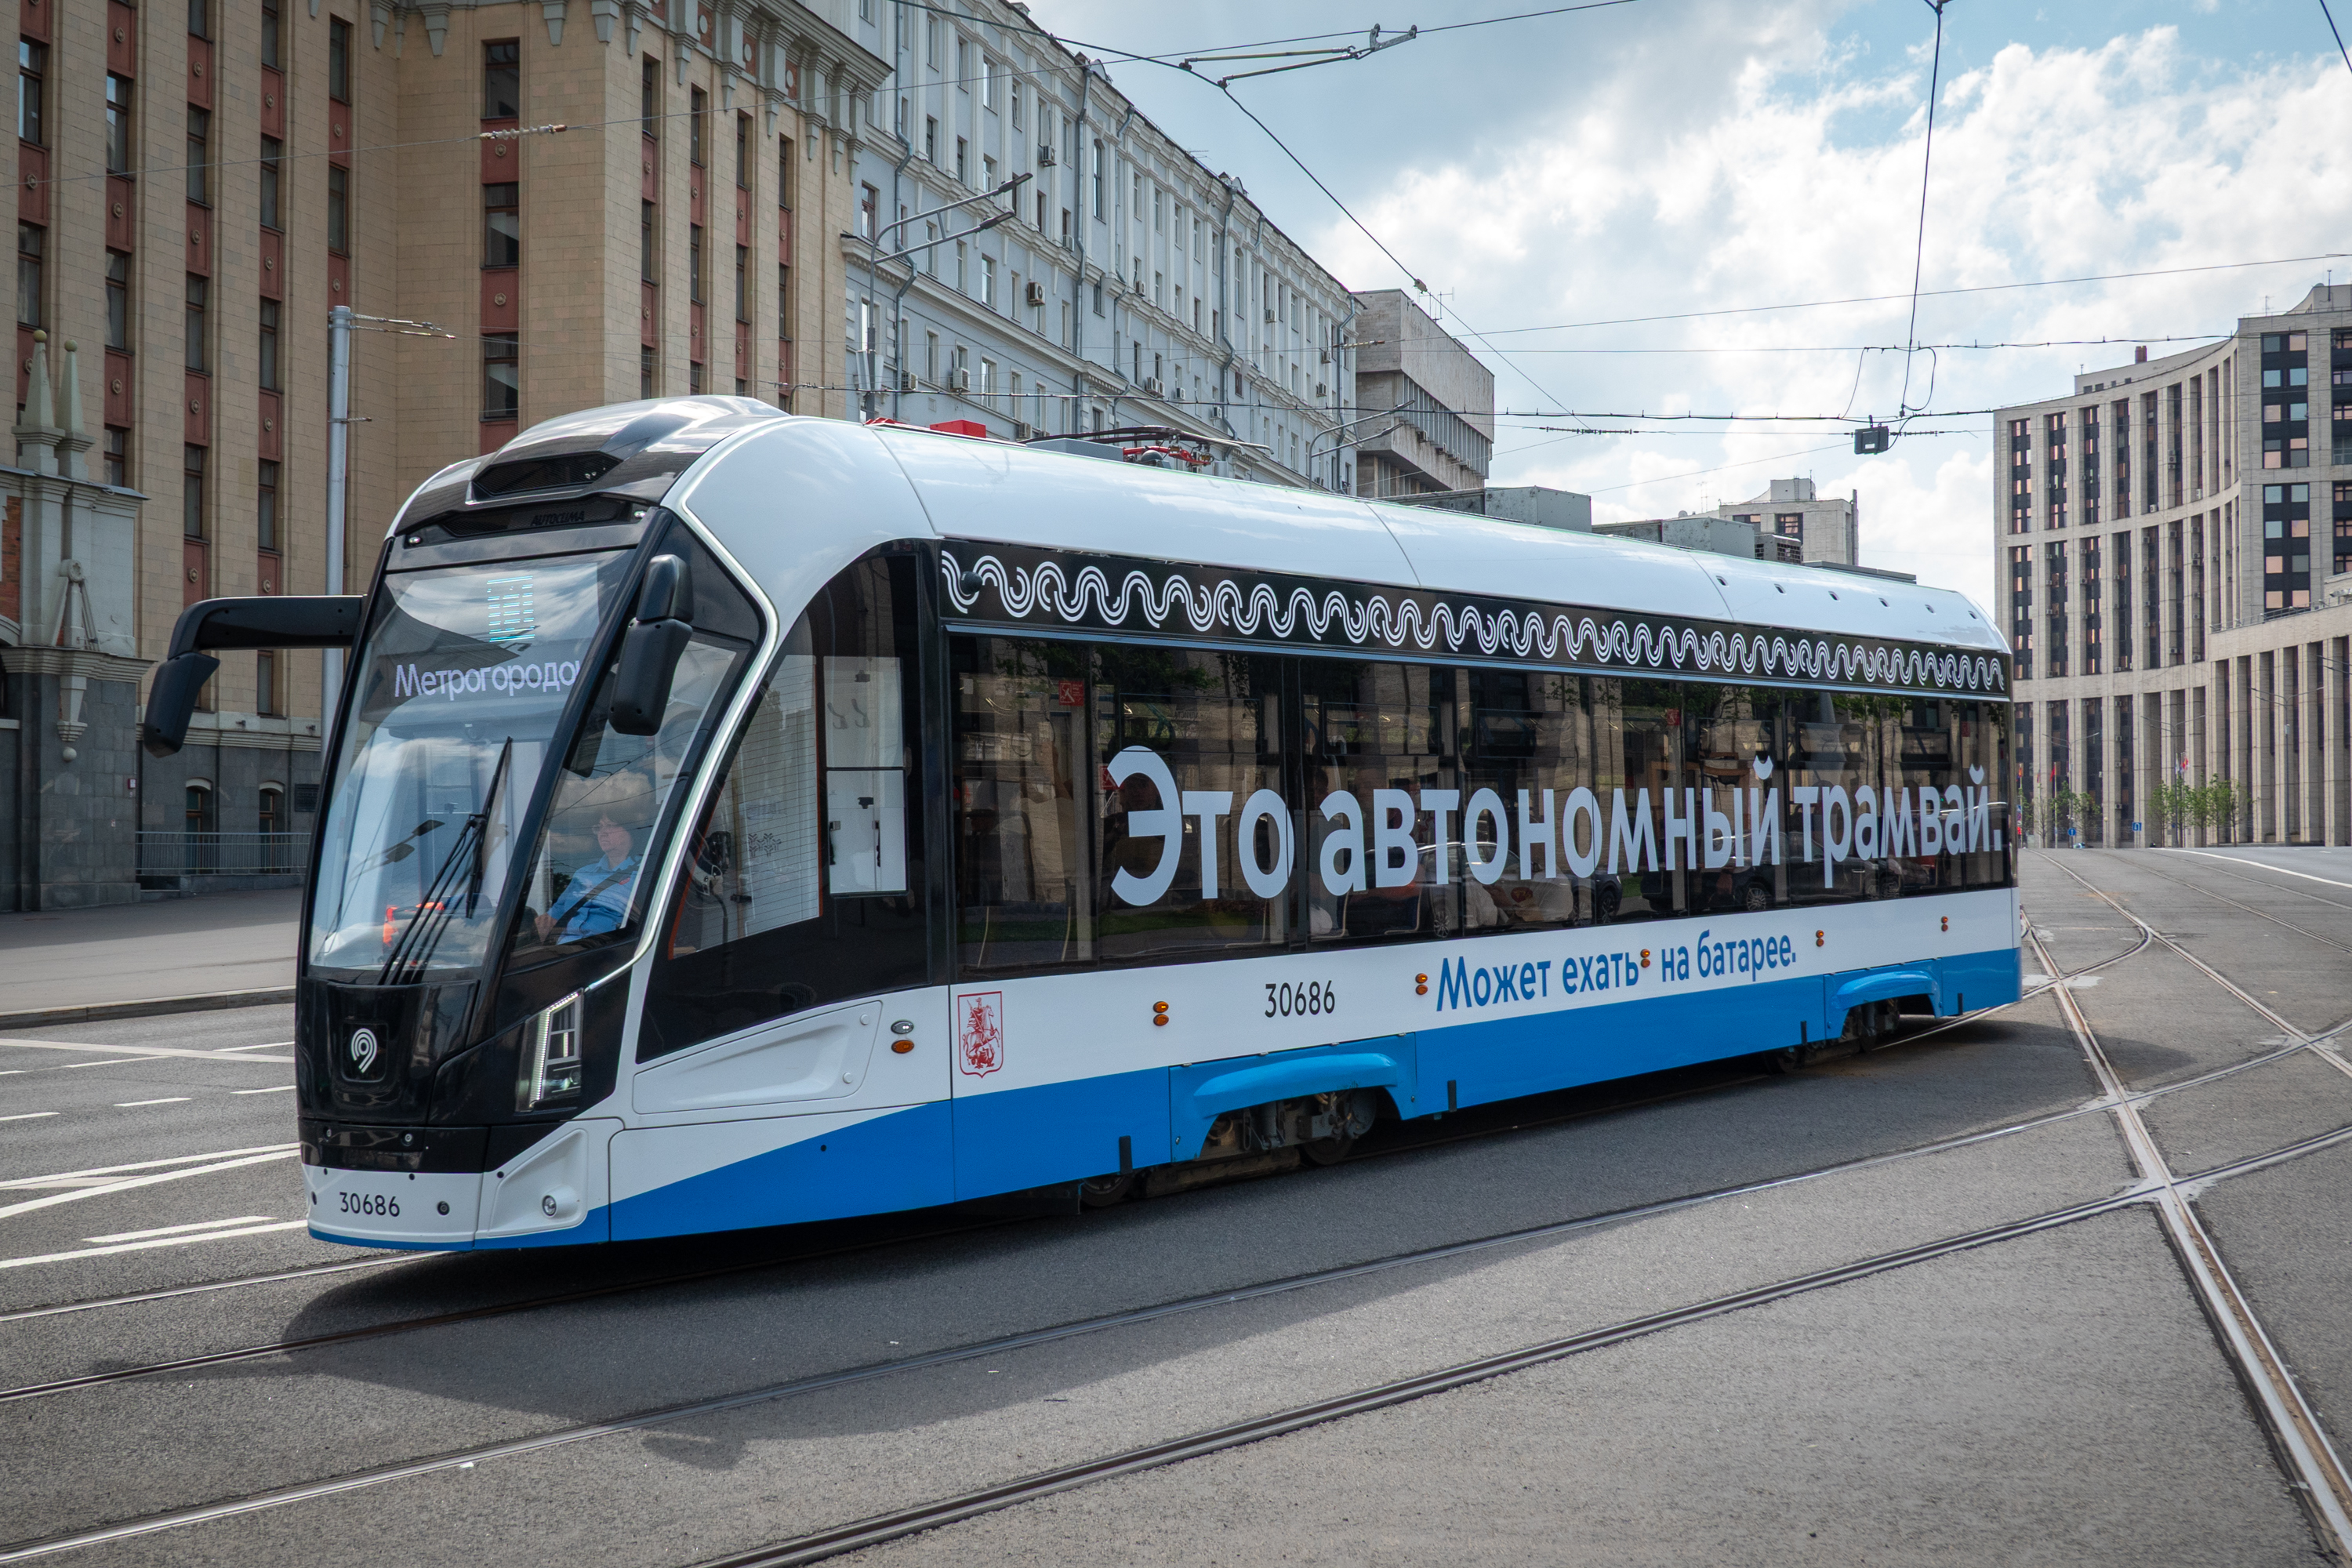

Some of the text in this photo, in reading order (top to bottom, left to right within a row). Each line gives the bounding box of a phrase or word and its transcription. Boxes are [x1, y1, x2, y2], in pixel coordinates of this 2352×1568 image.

[530, 510, 586, 526] AUTOCLIMA
[1107, 745, 2002, 906] Это автономный трамвай.
[1436, 929, 1797, 1012] Может ехать на батарее.
[1264, 980, 1336, 1018] 30686
[339, 1192, 401, 1218] 30686
